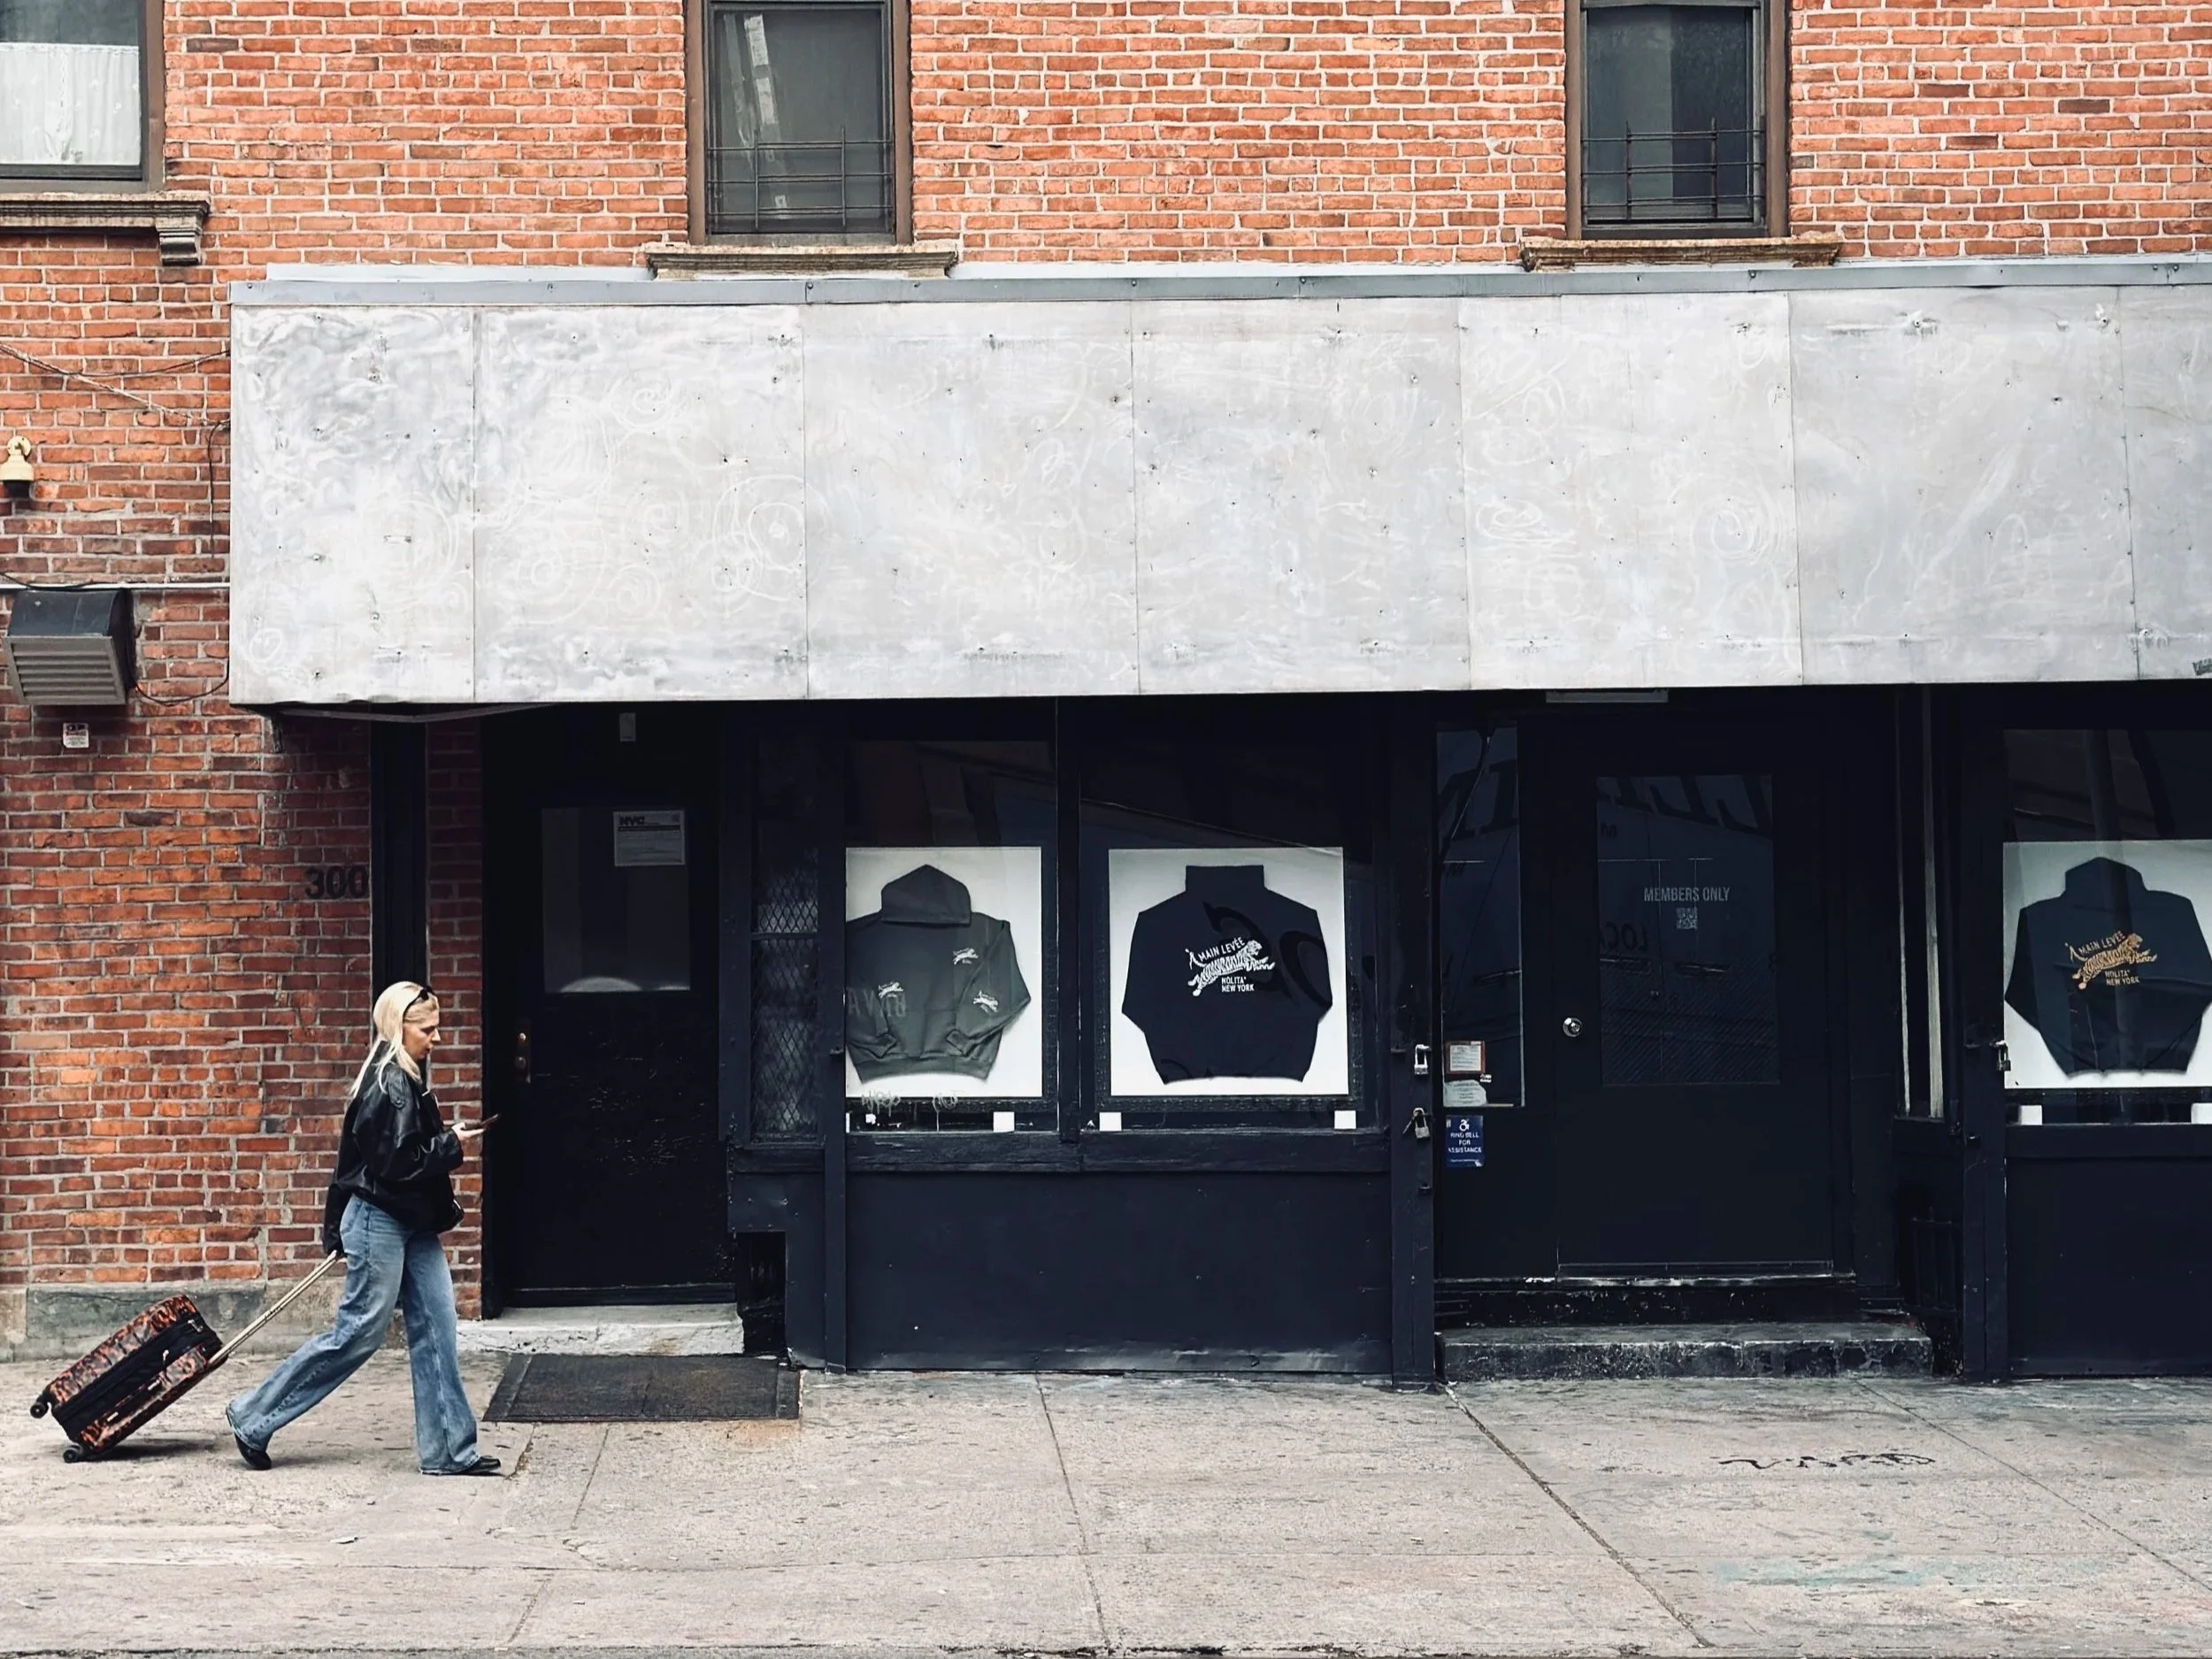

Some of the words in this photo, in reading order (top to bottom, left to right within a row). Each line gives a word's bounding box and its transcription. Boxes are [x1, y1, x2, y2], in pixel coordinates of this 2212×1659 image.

[305, 866, 368, 899] 300
[1644, 887, 1699, 902] MEMBERS
[1702, 887, 1731, 902] ONLY
[1198, 945, 1220, 962] MAIN
[1221, 936, 1246, 955] LEVÉE
[2078, 941, 2101, 955] MAIN
